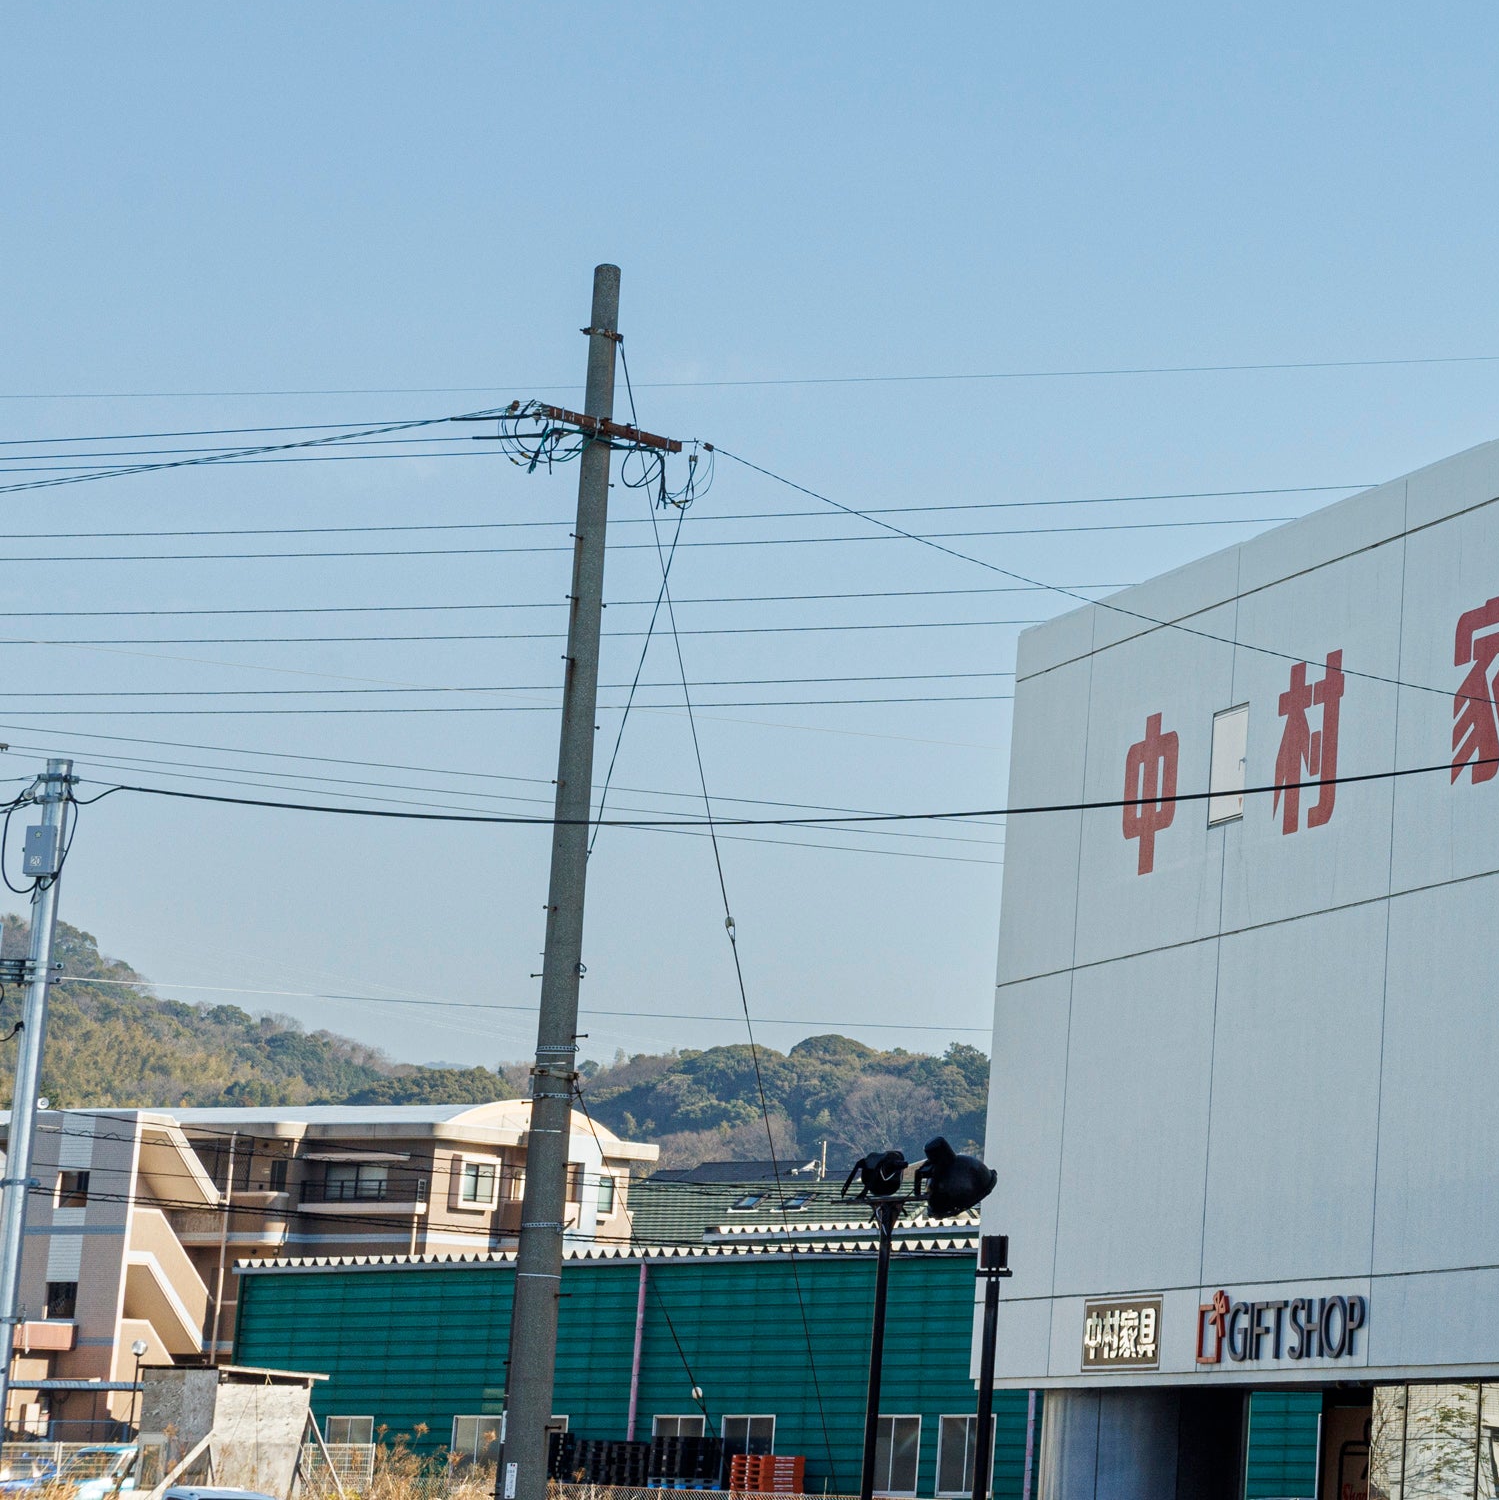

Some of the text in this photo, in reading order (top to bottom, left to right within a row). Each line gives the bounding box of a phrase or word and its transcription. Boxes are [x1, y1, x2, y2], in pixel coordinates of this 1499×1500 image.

[1084, 1307, 1156, 1360] 中村家具
[1227, 1295, 1365, 1362] GIFT SHOP
